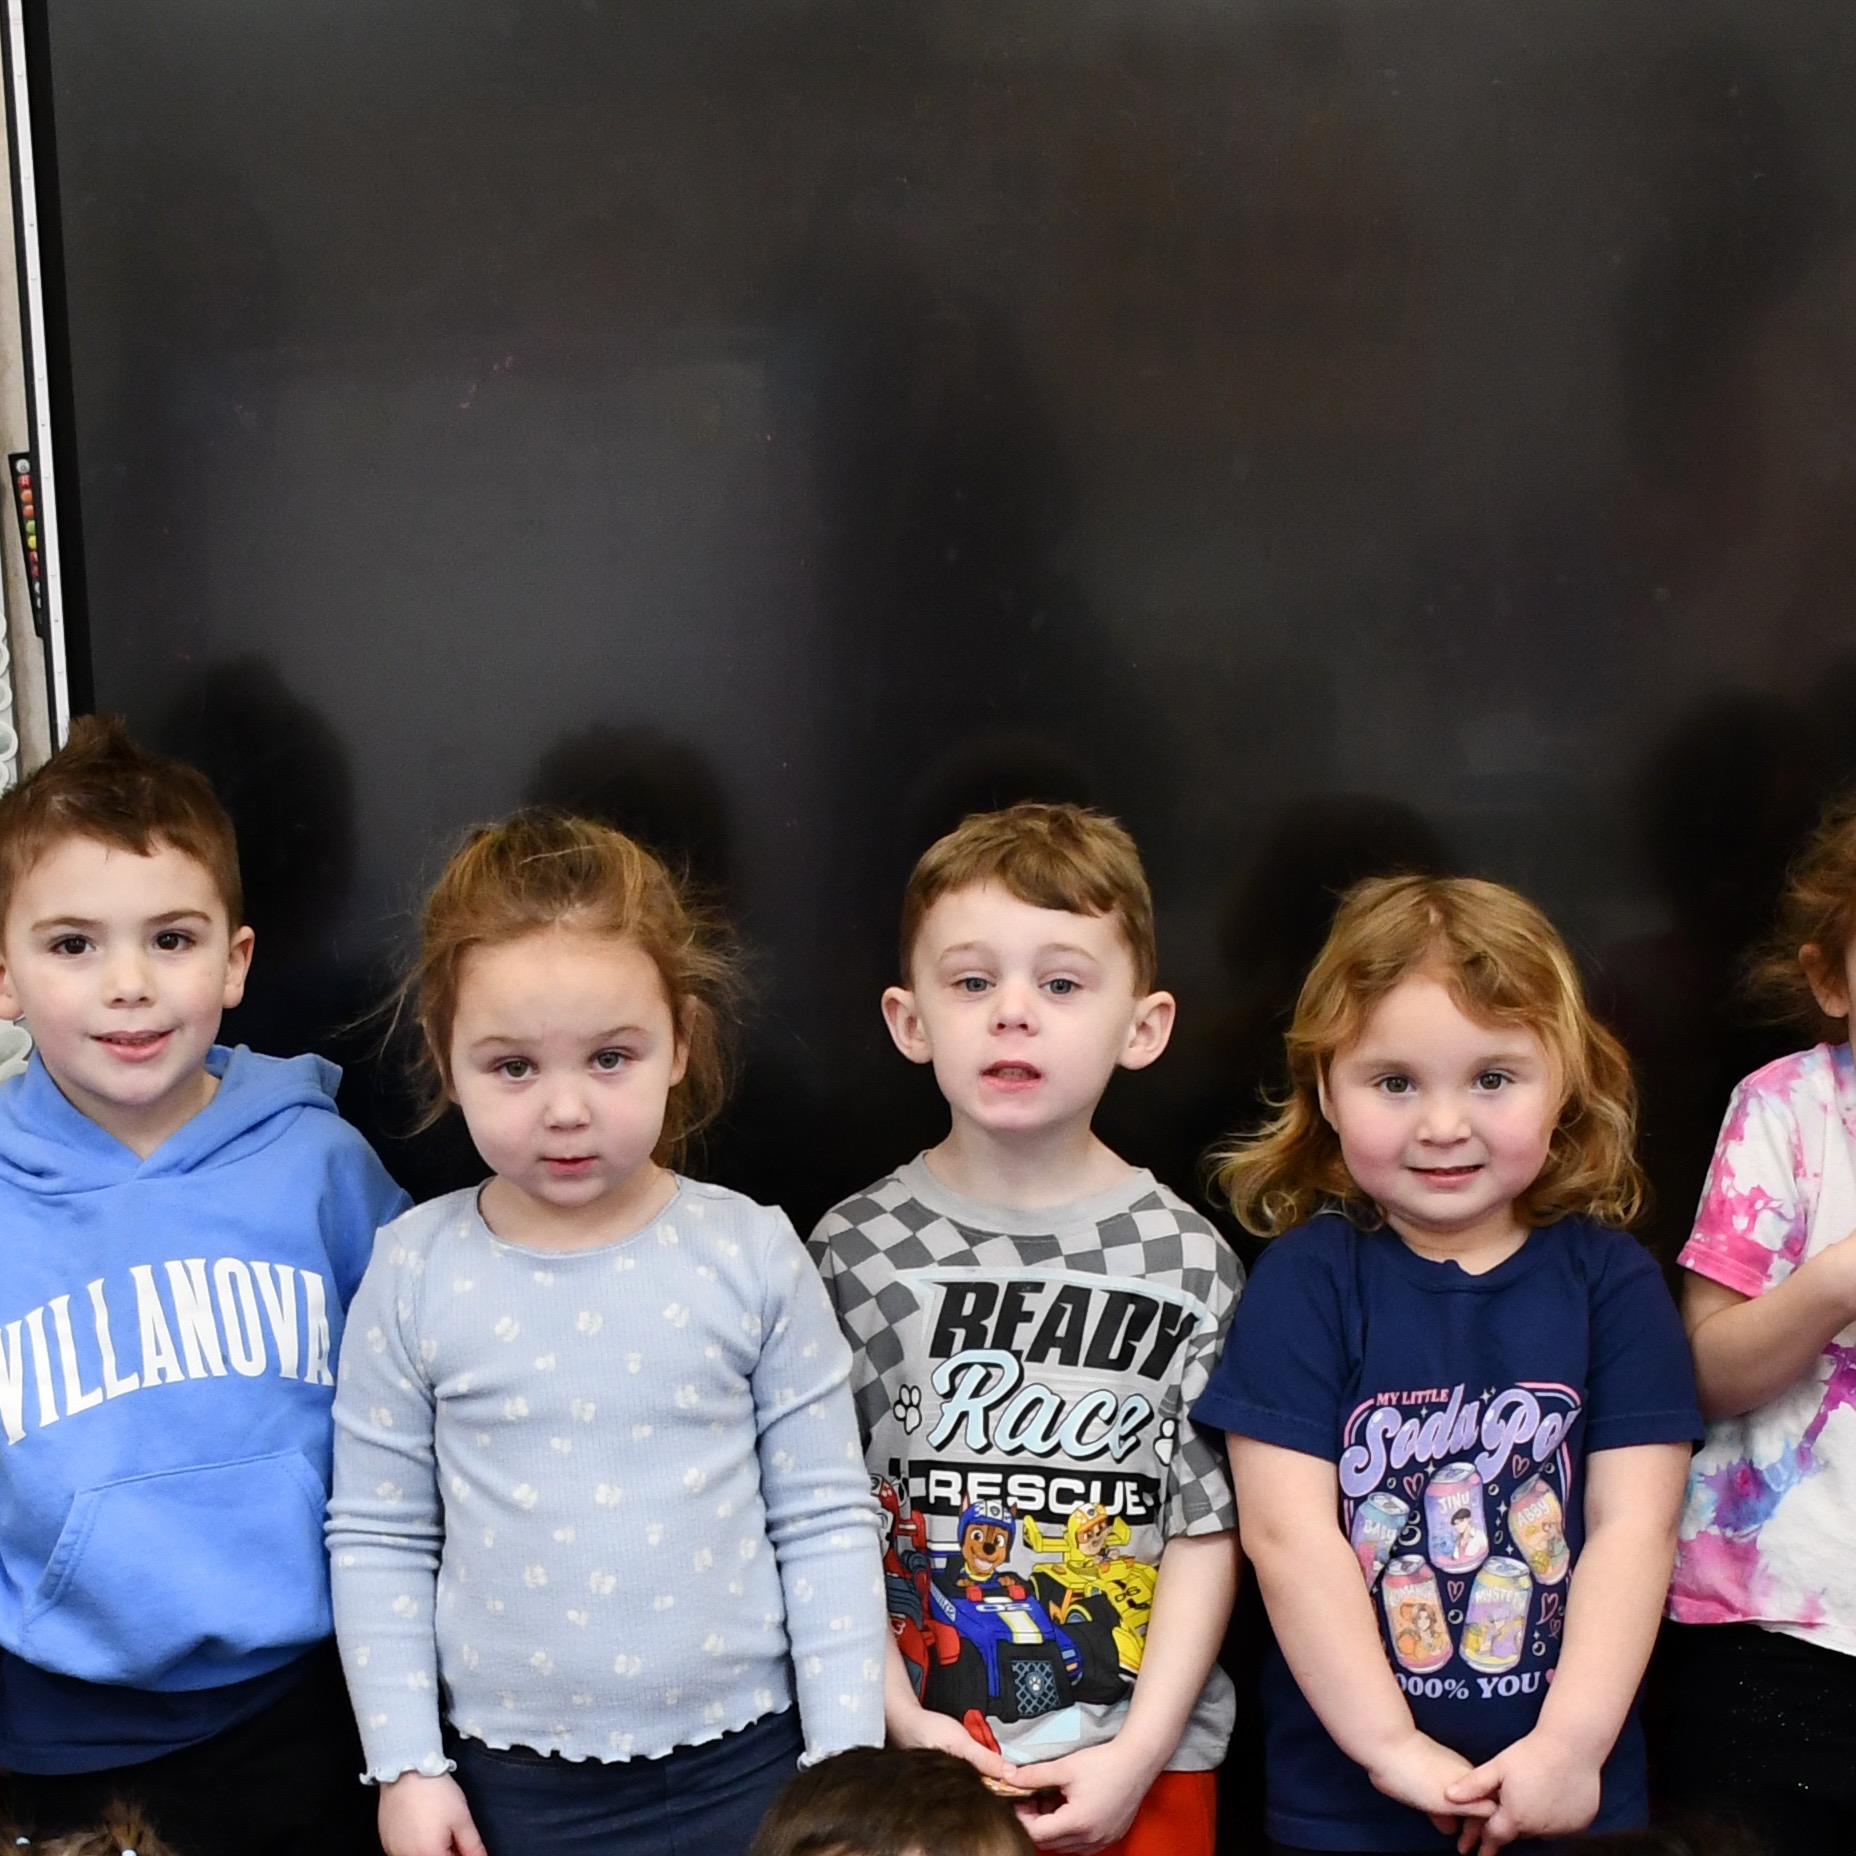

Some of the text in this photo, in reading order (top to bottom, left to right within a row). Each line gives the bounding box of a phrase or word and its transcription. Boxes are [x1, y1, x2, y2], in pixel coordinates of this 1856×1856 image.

[928, 1280, 1202, 1382] READY
[927, 1349, 1152, 1463] Race
[1376, 1388, 1449, 1406] MY LITTLE
[1339, 1383, 1480, 1497] Soda
[928, 1469, 1147, 1518] RESCUE
[1516, 1500, 1551, 1527] ABBY
[1476, 1670, 1542, 1695] YOU
